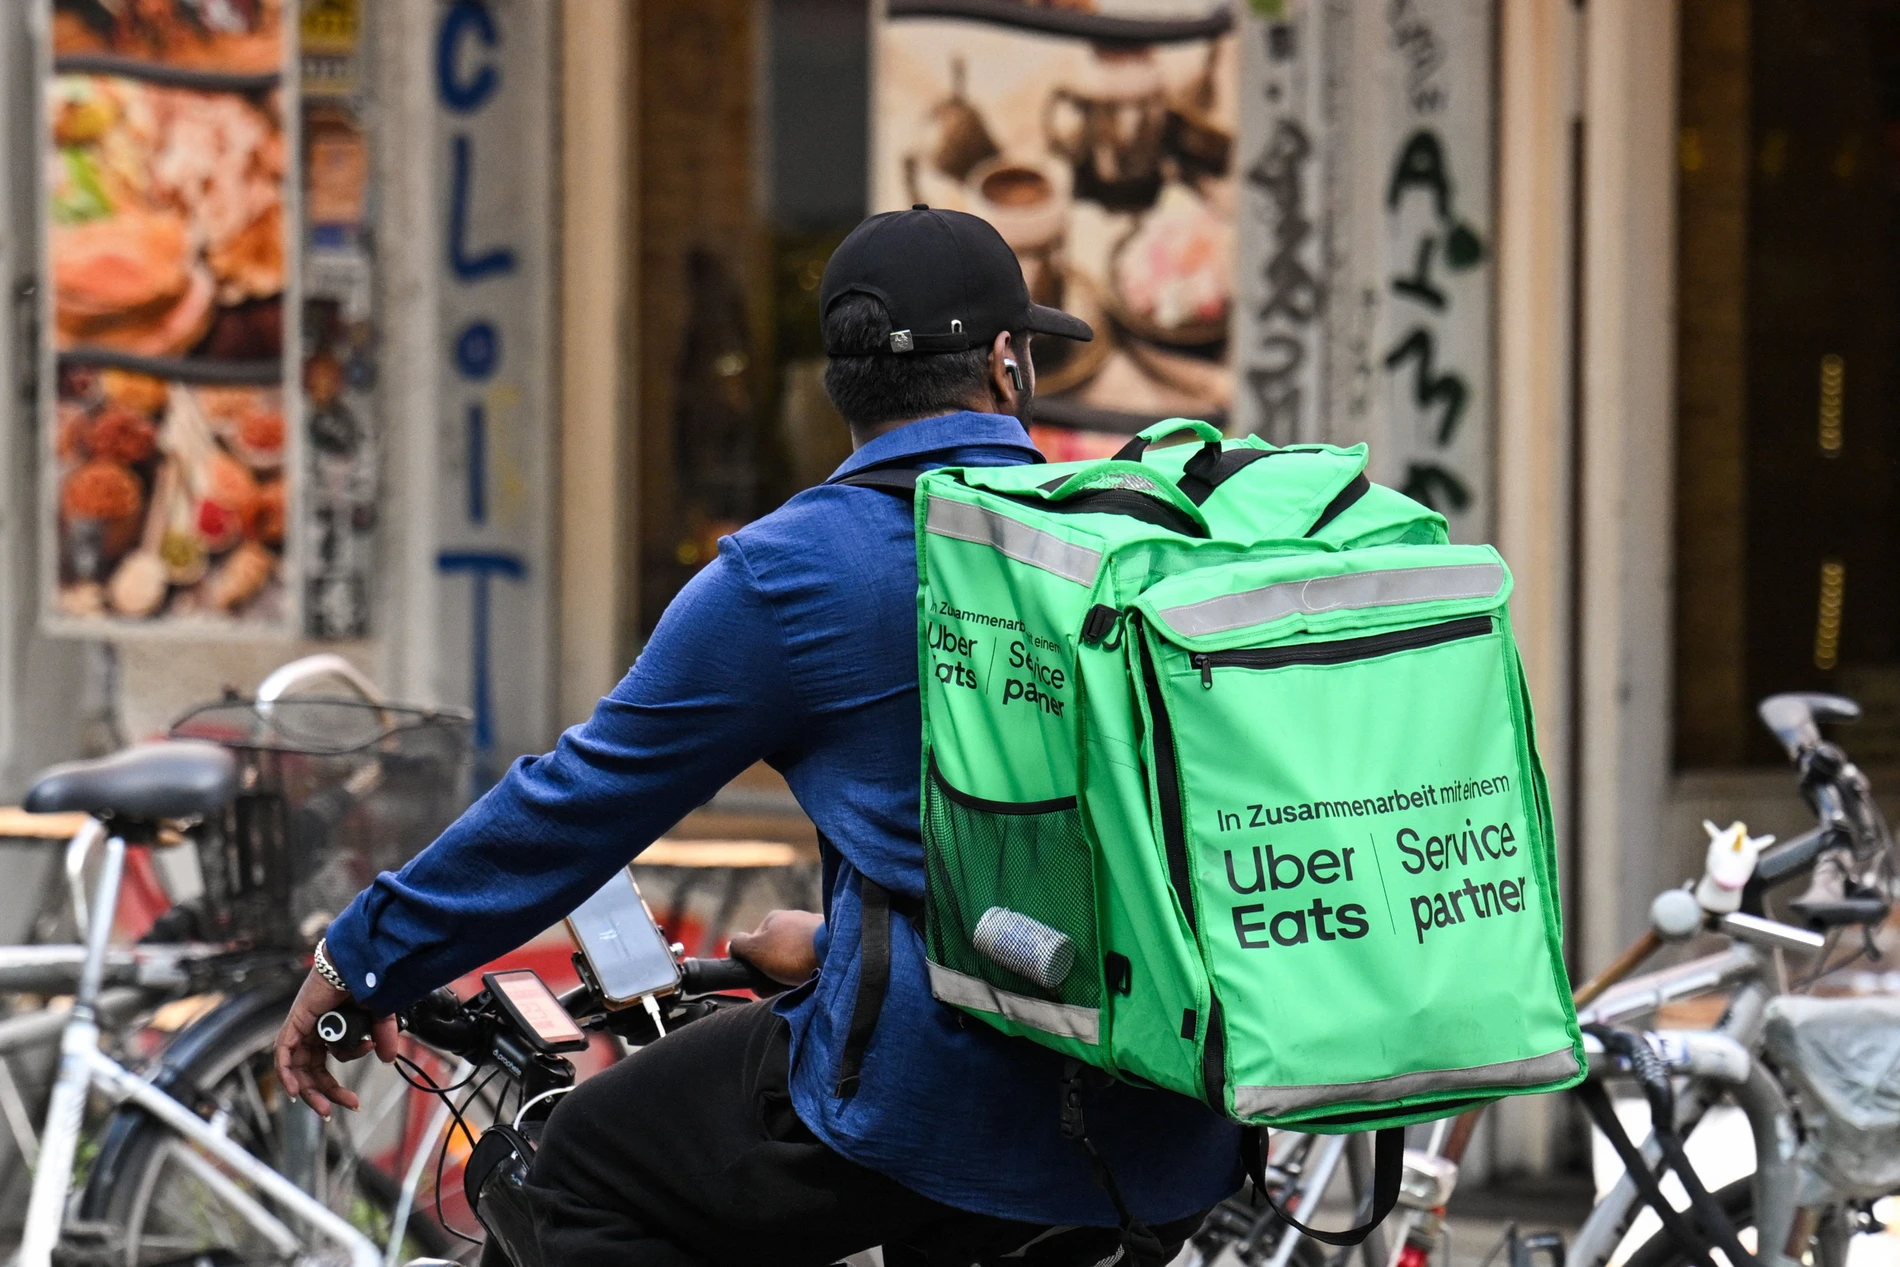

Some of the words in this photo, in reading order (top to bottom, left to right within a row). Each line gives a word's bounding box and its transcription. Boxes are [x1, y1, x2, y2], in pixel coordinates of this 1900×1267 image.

[927, 621, 978, 659] Uber
[933, 655, 977, 690] ats
[1218, 809, 1241, 831] In
[1246, 785, 1437, 828] Zusammenarbeit
[1440, 781, 1462, 804] mit
[1463, 774, 1510, 800] einem
[1223, 845, 1355, 895] Uber
[1396, 818, 1518, 875] Service
[1232, 898, 1370, 949] Eats
[1410, 876, 1527, 945] partner
